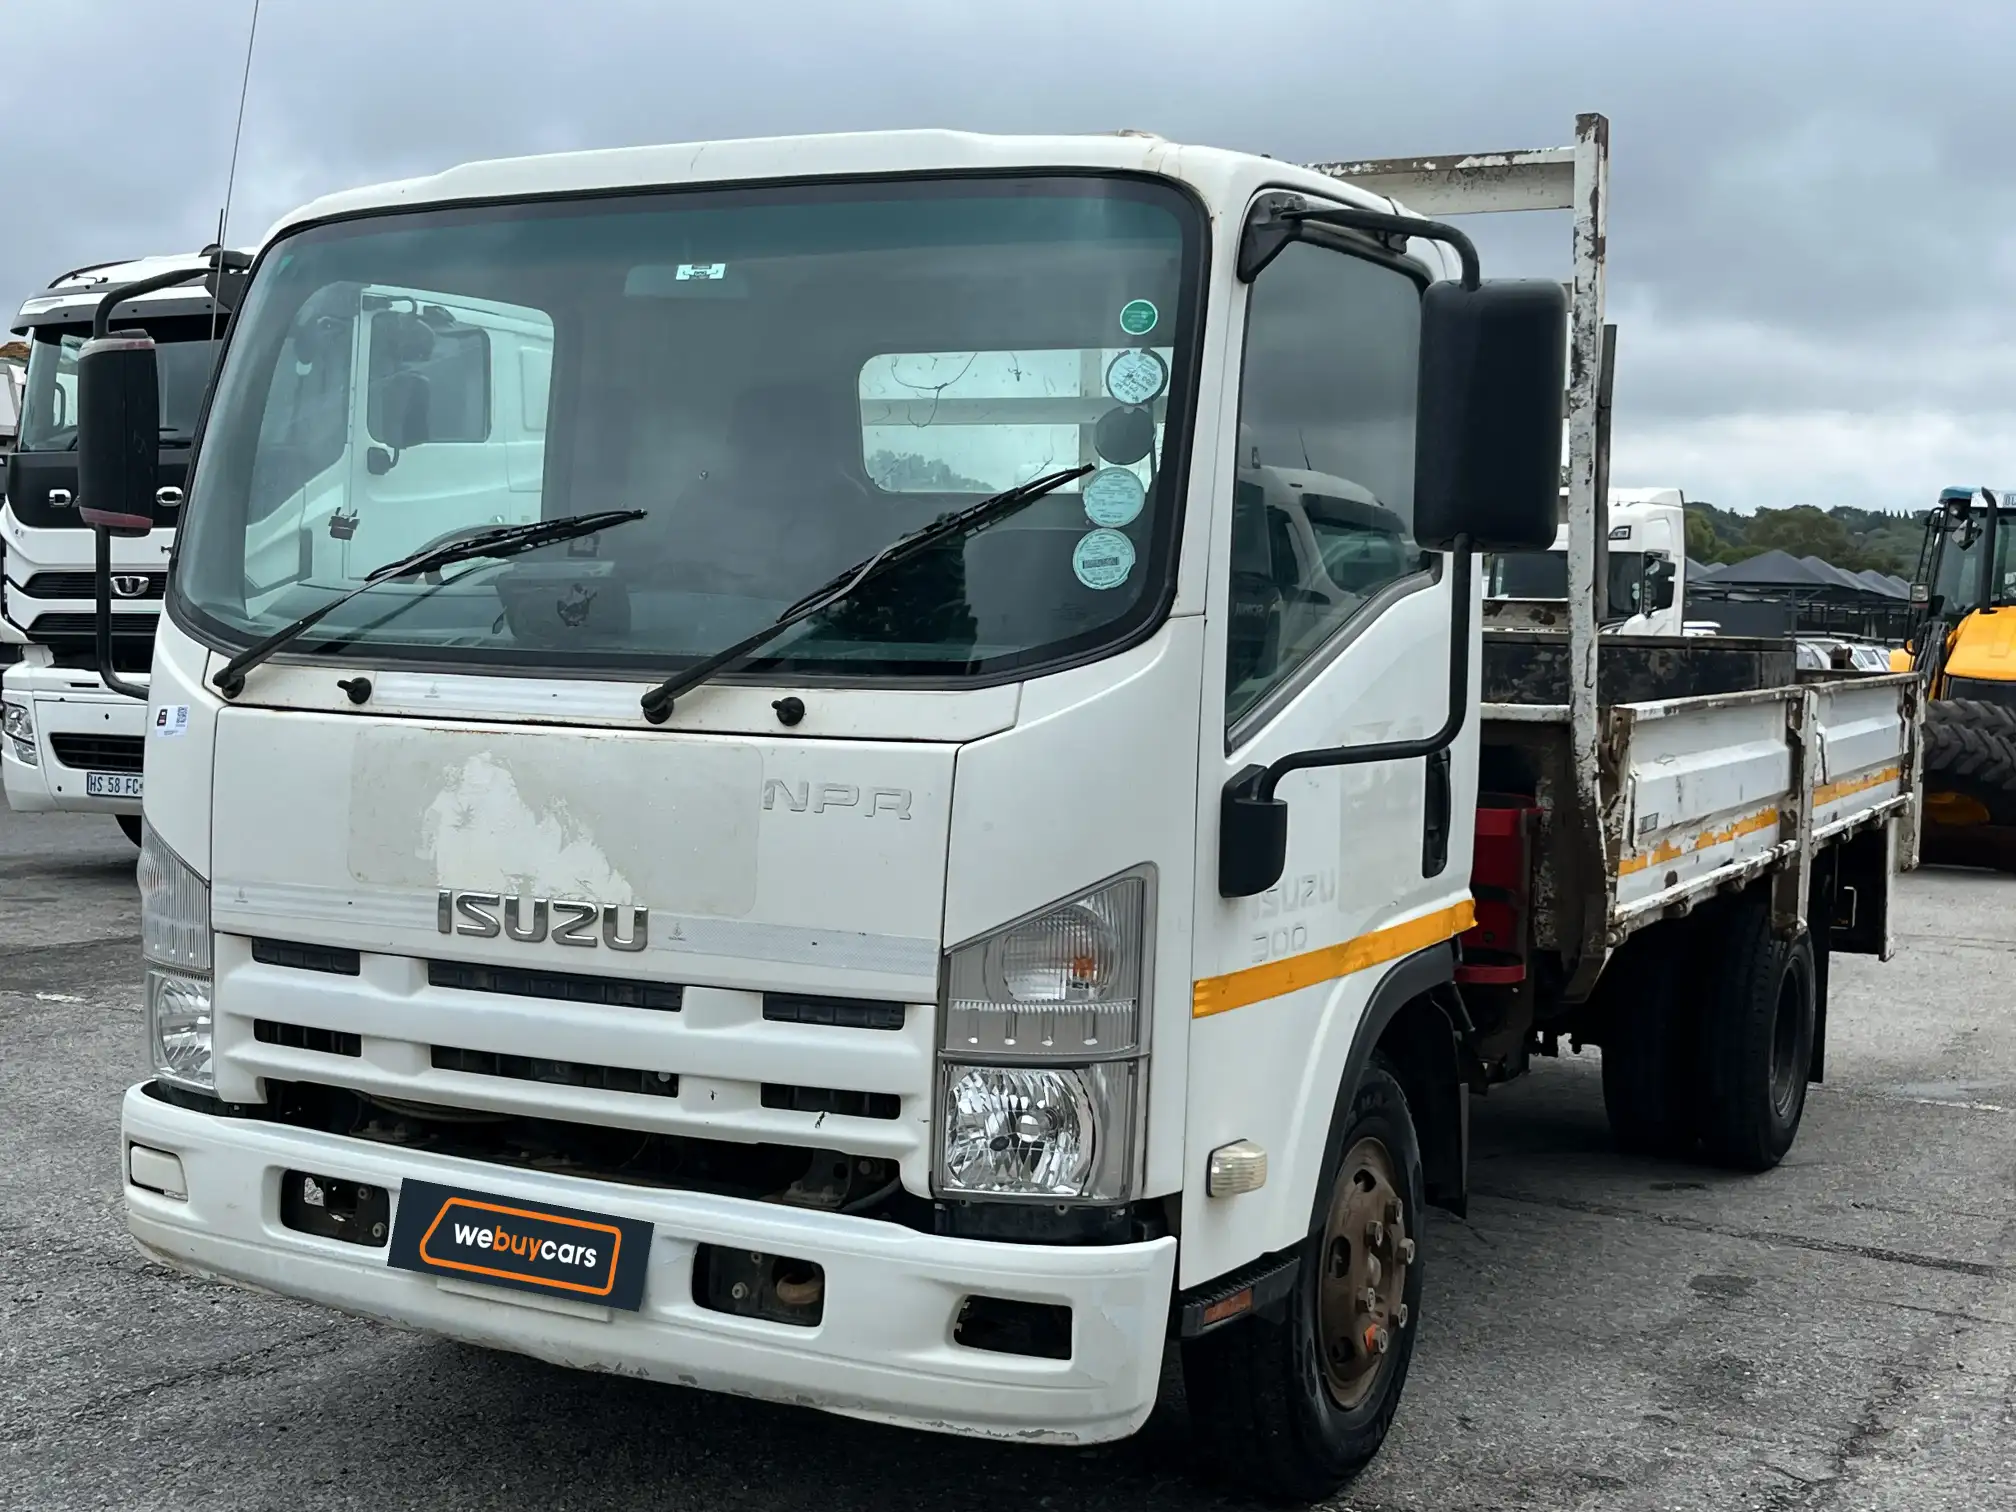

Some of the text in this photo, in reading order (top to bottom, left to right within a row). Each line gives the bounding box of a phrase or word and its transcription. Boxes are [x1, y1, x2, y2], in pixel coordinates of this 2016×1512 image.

[90, 775, 139, 794] HS 58 FC
[763, 779, 912, 820] NPR
[437, 889, 649, 952] ISUZU
[1251, 924, 1308, 962] 300
